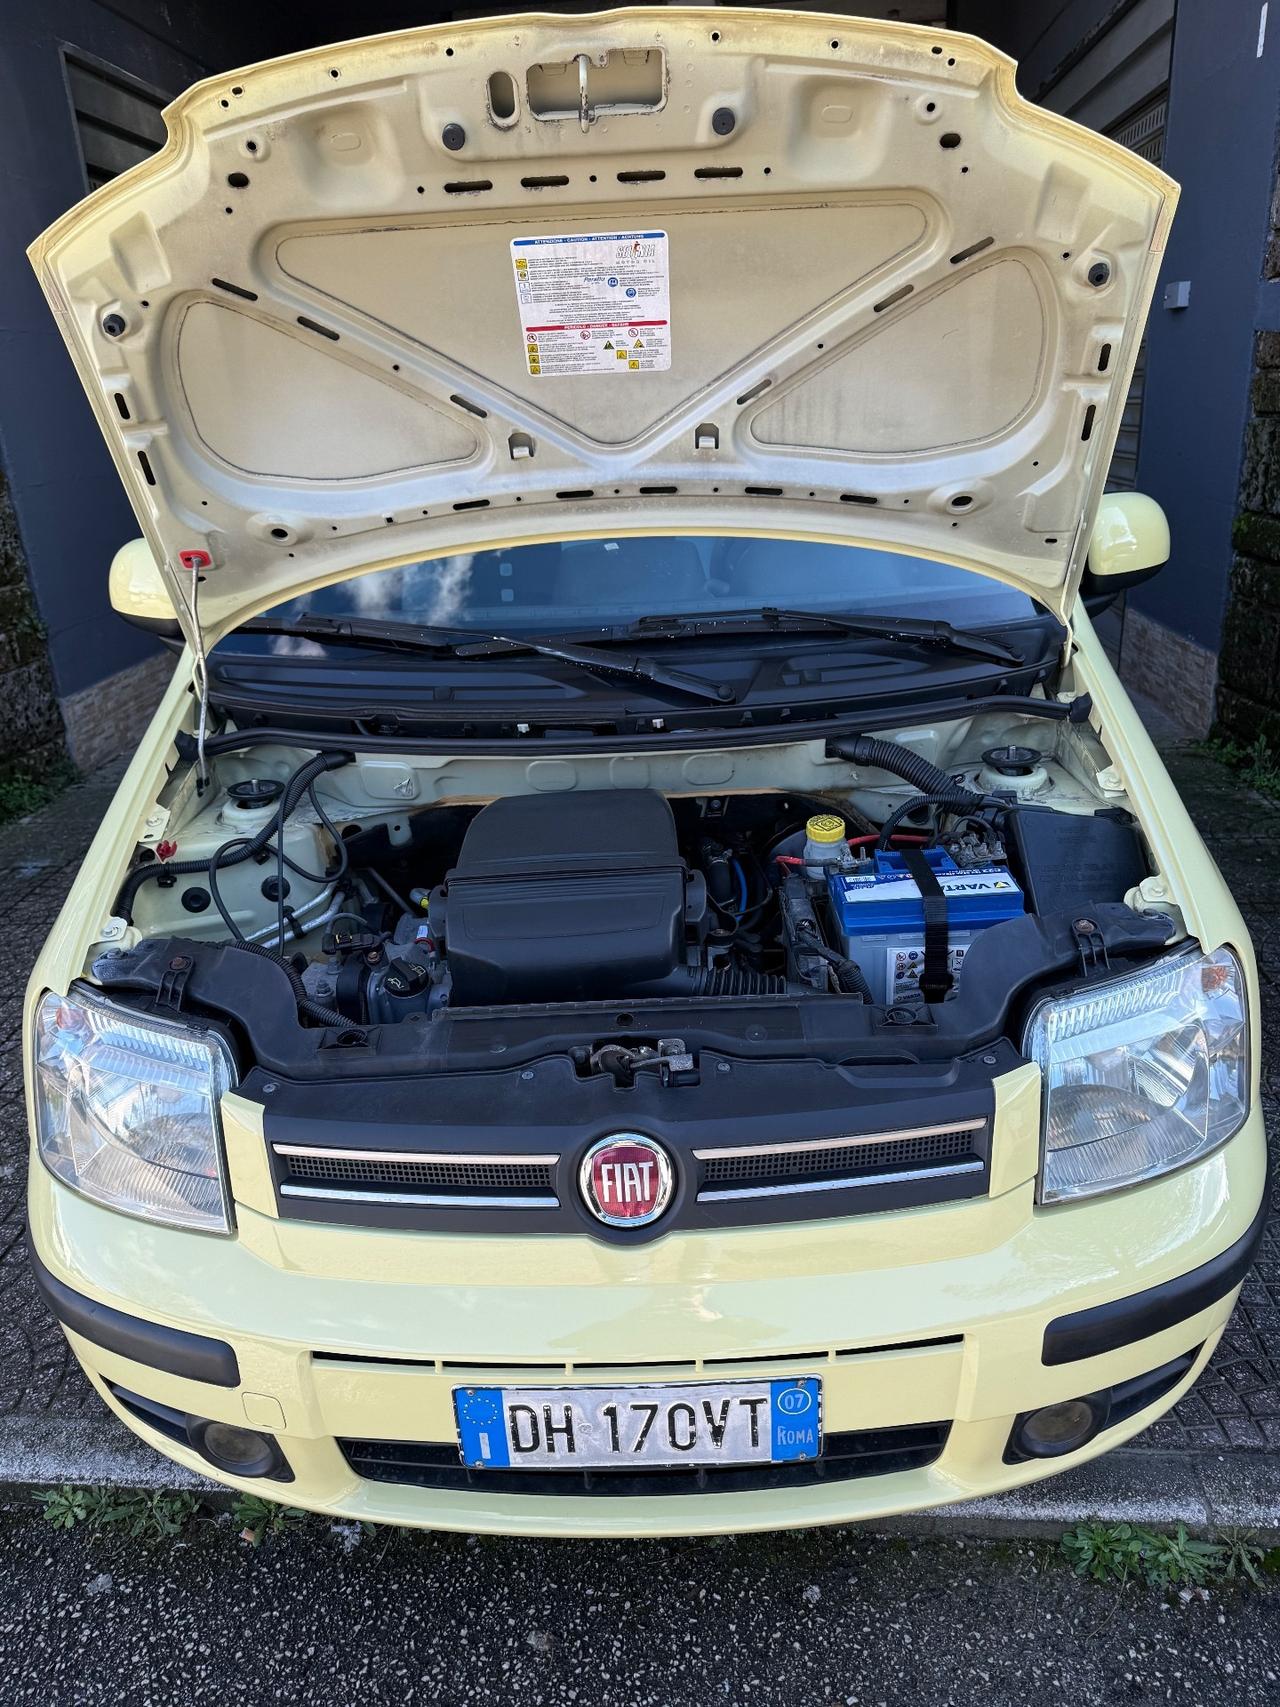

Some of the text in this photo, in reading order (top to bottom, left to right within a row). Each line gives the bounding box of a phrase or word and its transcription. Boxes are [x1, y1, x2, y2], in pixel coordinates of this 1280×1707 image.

[601, 1161, 653, 1203] FIAT
[784, 1393, 805, 1410] 07
[508, 1404, 576, 1453] DH
